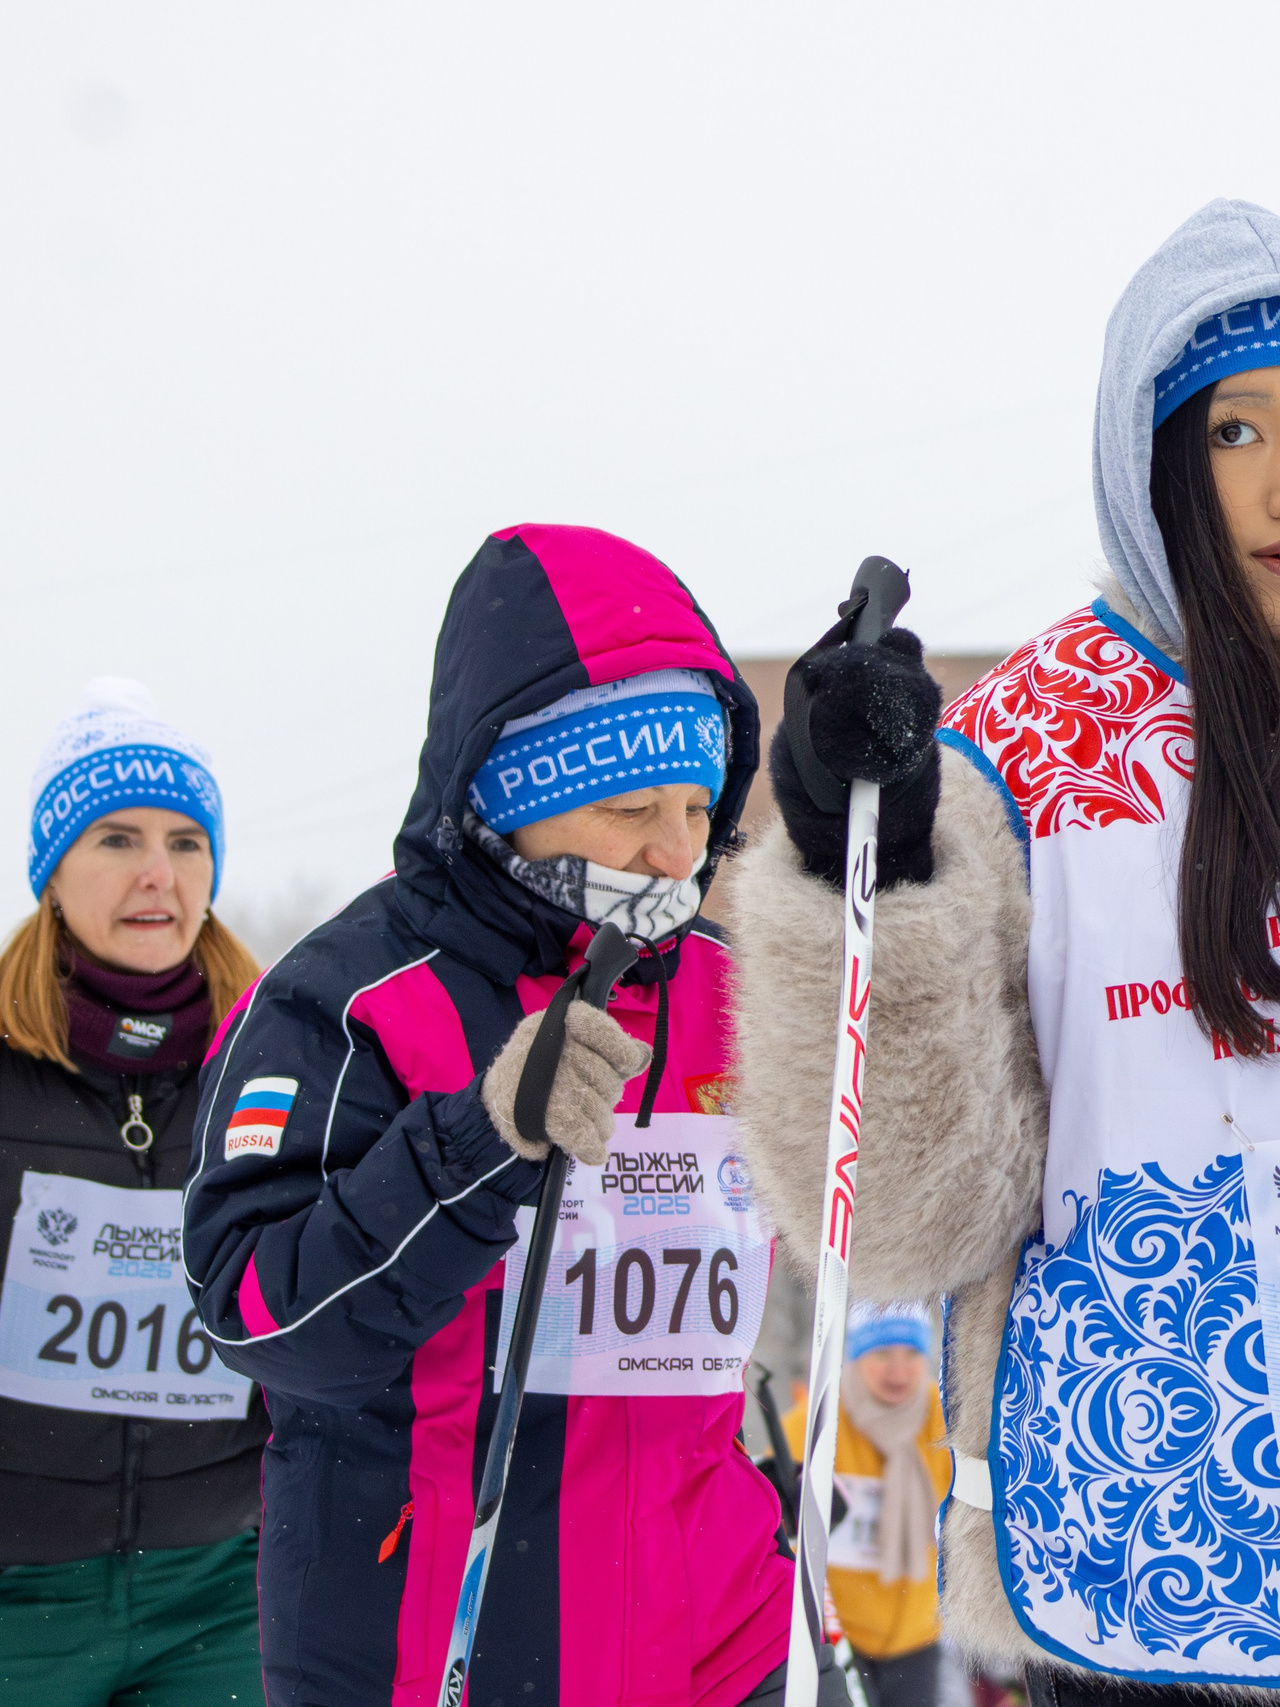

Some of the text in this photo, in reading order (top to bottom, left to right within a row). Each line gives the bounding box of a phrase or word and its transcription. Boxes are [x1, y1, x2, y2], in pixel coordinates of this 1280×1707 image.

[498, 720, 686, 799] РОССИИ
[38, 758, 175, 839] РОССИИ
[828, 954, 871, 1262] SPINE
[228, 1134, 274, 1151] RUSSIA
[604, 1151, 700, 1172] ЛЫЖНЯ
[601, 1174, 705, 1194] РОССИИ
[622, 1195, 692, 1216] 2025
[99, 1223, 182, 1243] ЛЫЖНЯ
[107, 1259, 173, 1279] 2025
[565, 1247, 739, 1335] 1076
[38, 1294, 213, 1376] 2016
[618, 1357, 694, 1371] ОМСКАЯ
[91, 1387, 158, 1403] ОМСКАЯ
